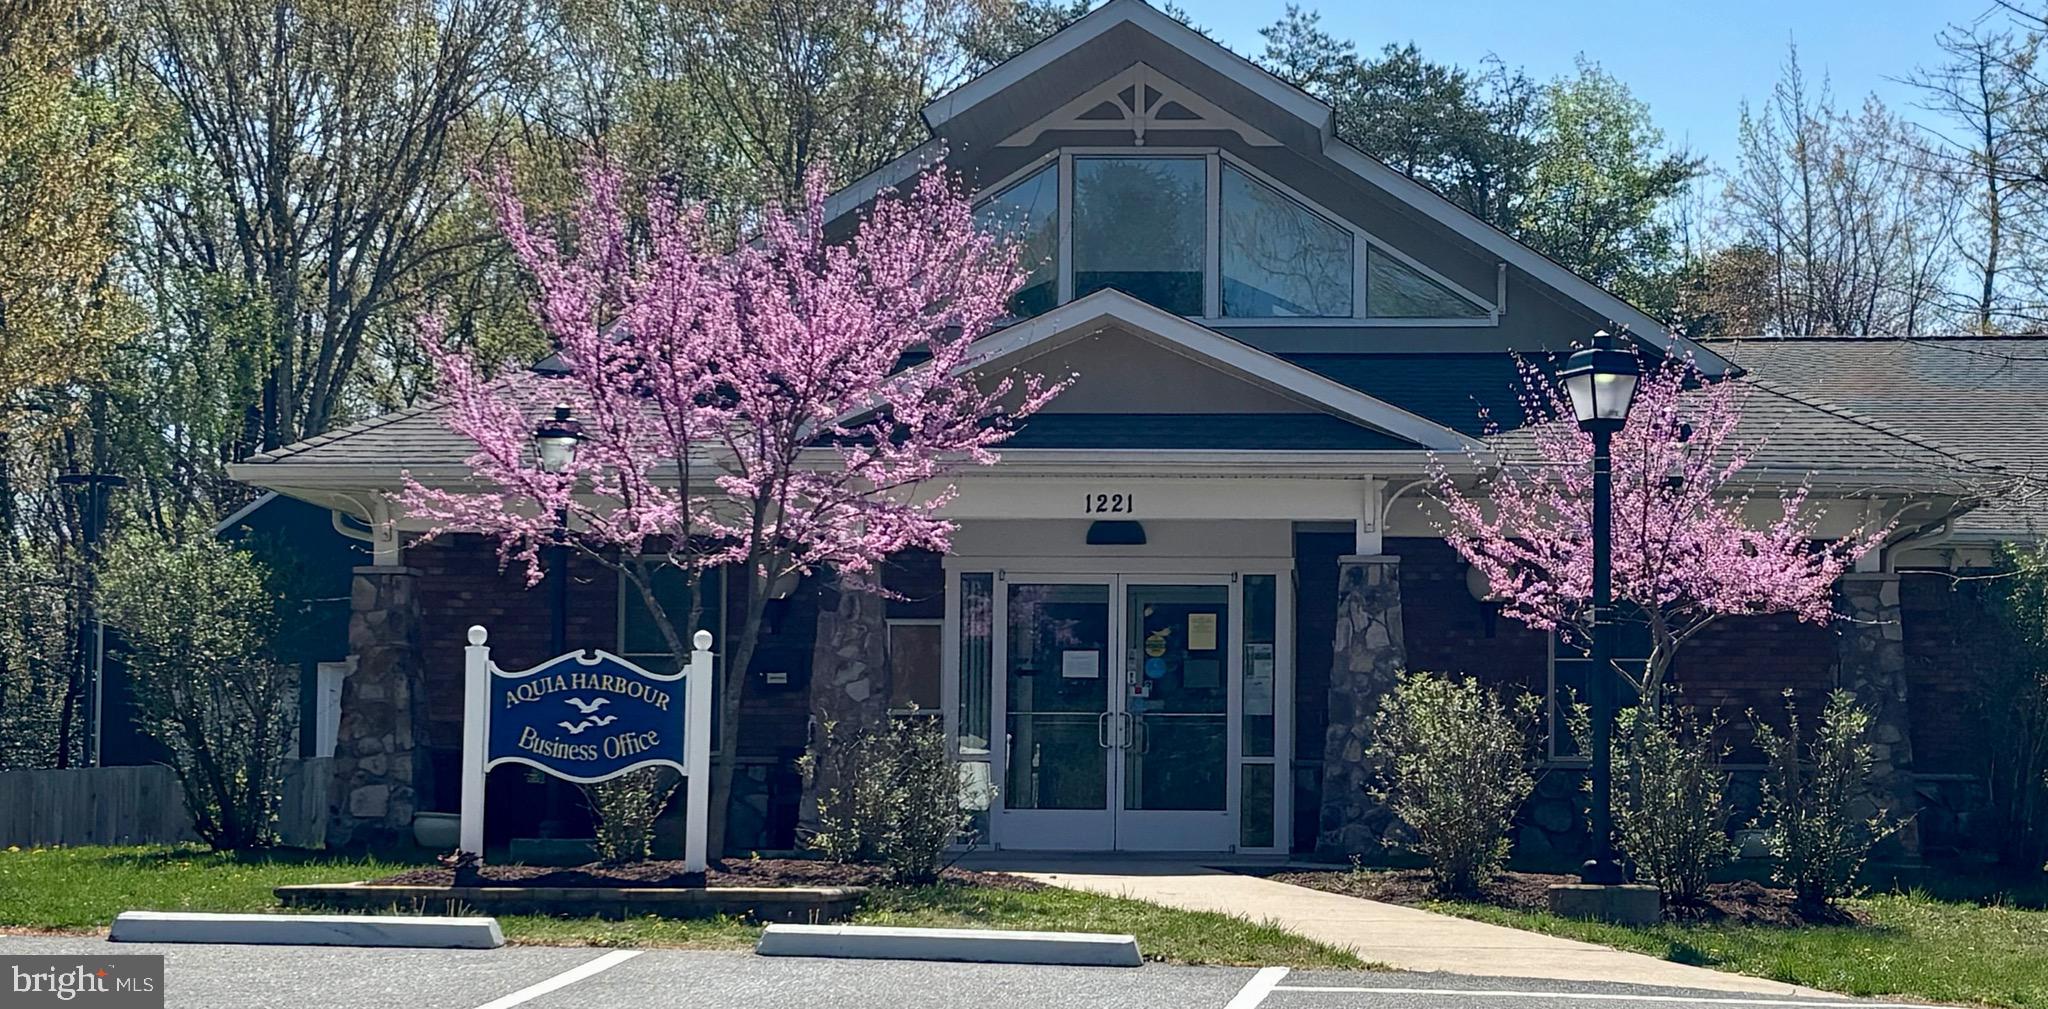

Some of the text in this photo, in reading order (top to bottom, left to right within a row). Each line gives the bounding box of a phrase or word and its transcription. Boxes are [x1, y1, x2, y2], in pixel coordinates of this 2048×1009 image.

[1085, 493, 1133, 513] 1221
[505, 673, 671, 711] AQUIA HARBOUR
[517, 726, 661, 761] Business Office
